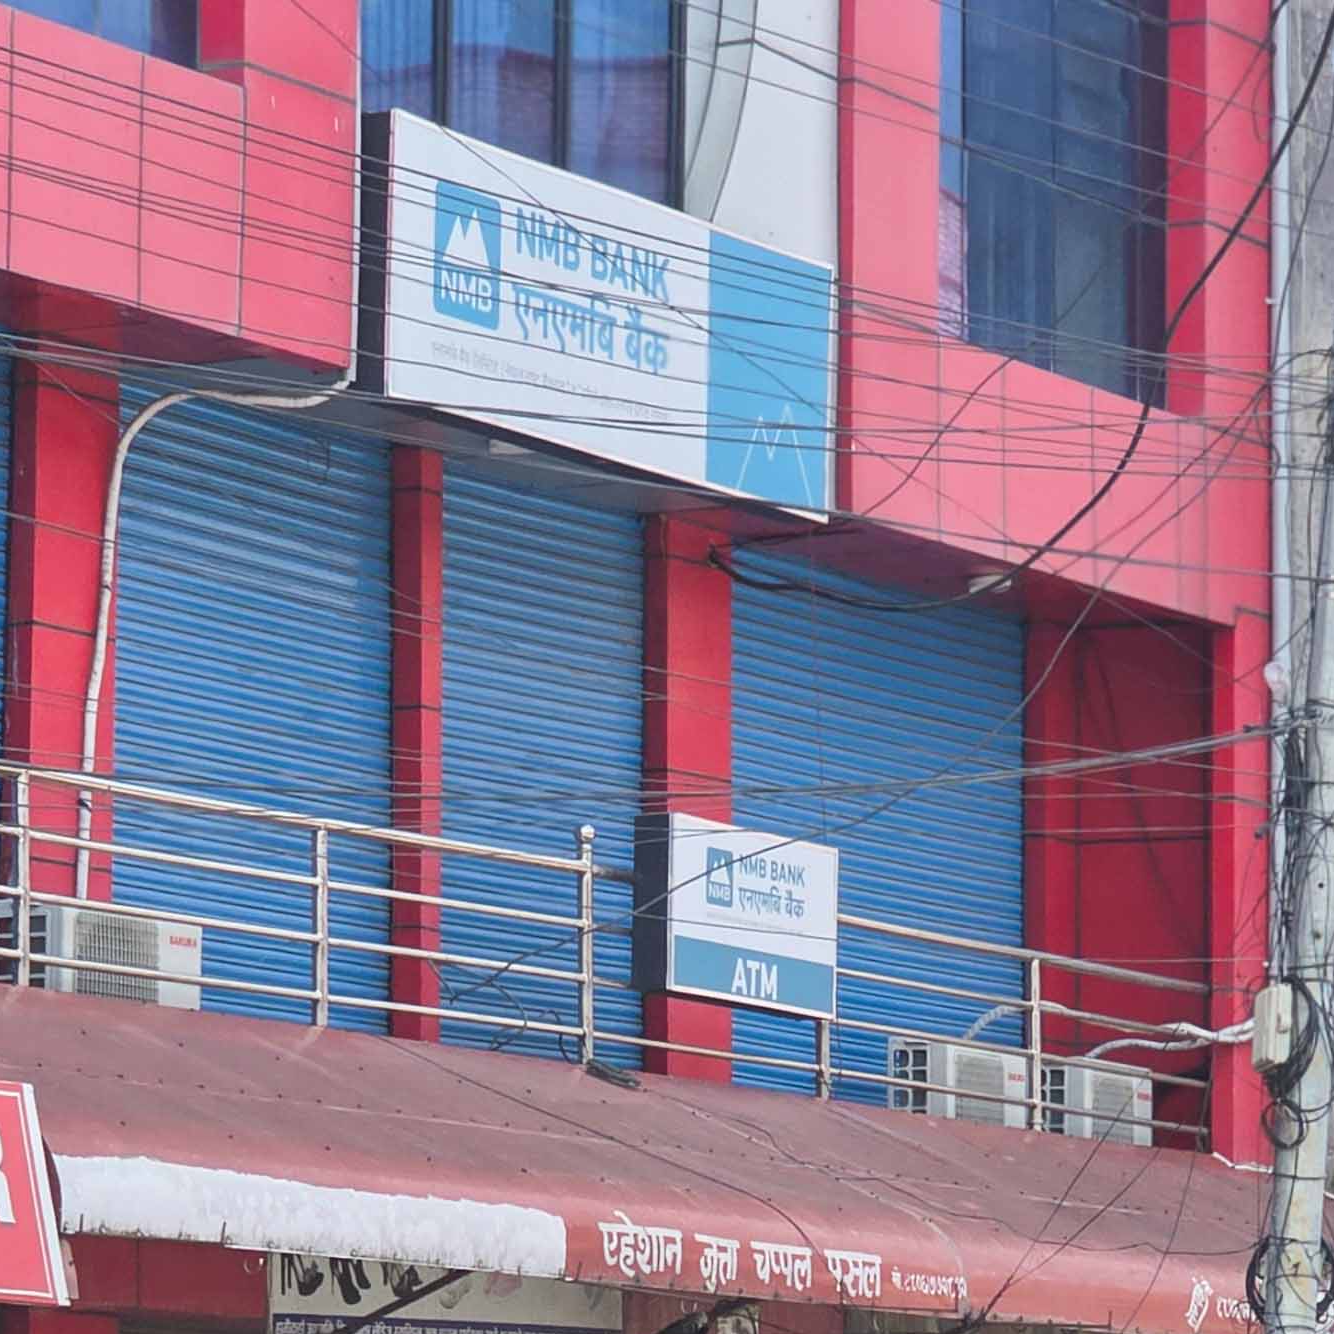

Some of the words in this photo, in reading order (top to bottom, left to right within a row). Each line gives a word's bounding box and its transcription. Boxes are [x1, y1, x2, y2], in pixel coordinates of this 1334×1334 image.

[515, 205, 581, 271] NMB
[590, 232, 670, 306] BANK
[439, 266, 493, 314] NMB
[739, 854, 766, 878] NMB
[770, 860, 805, 888] BANK
[731, 957, 778, 1001] ATM
